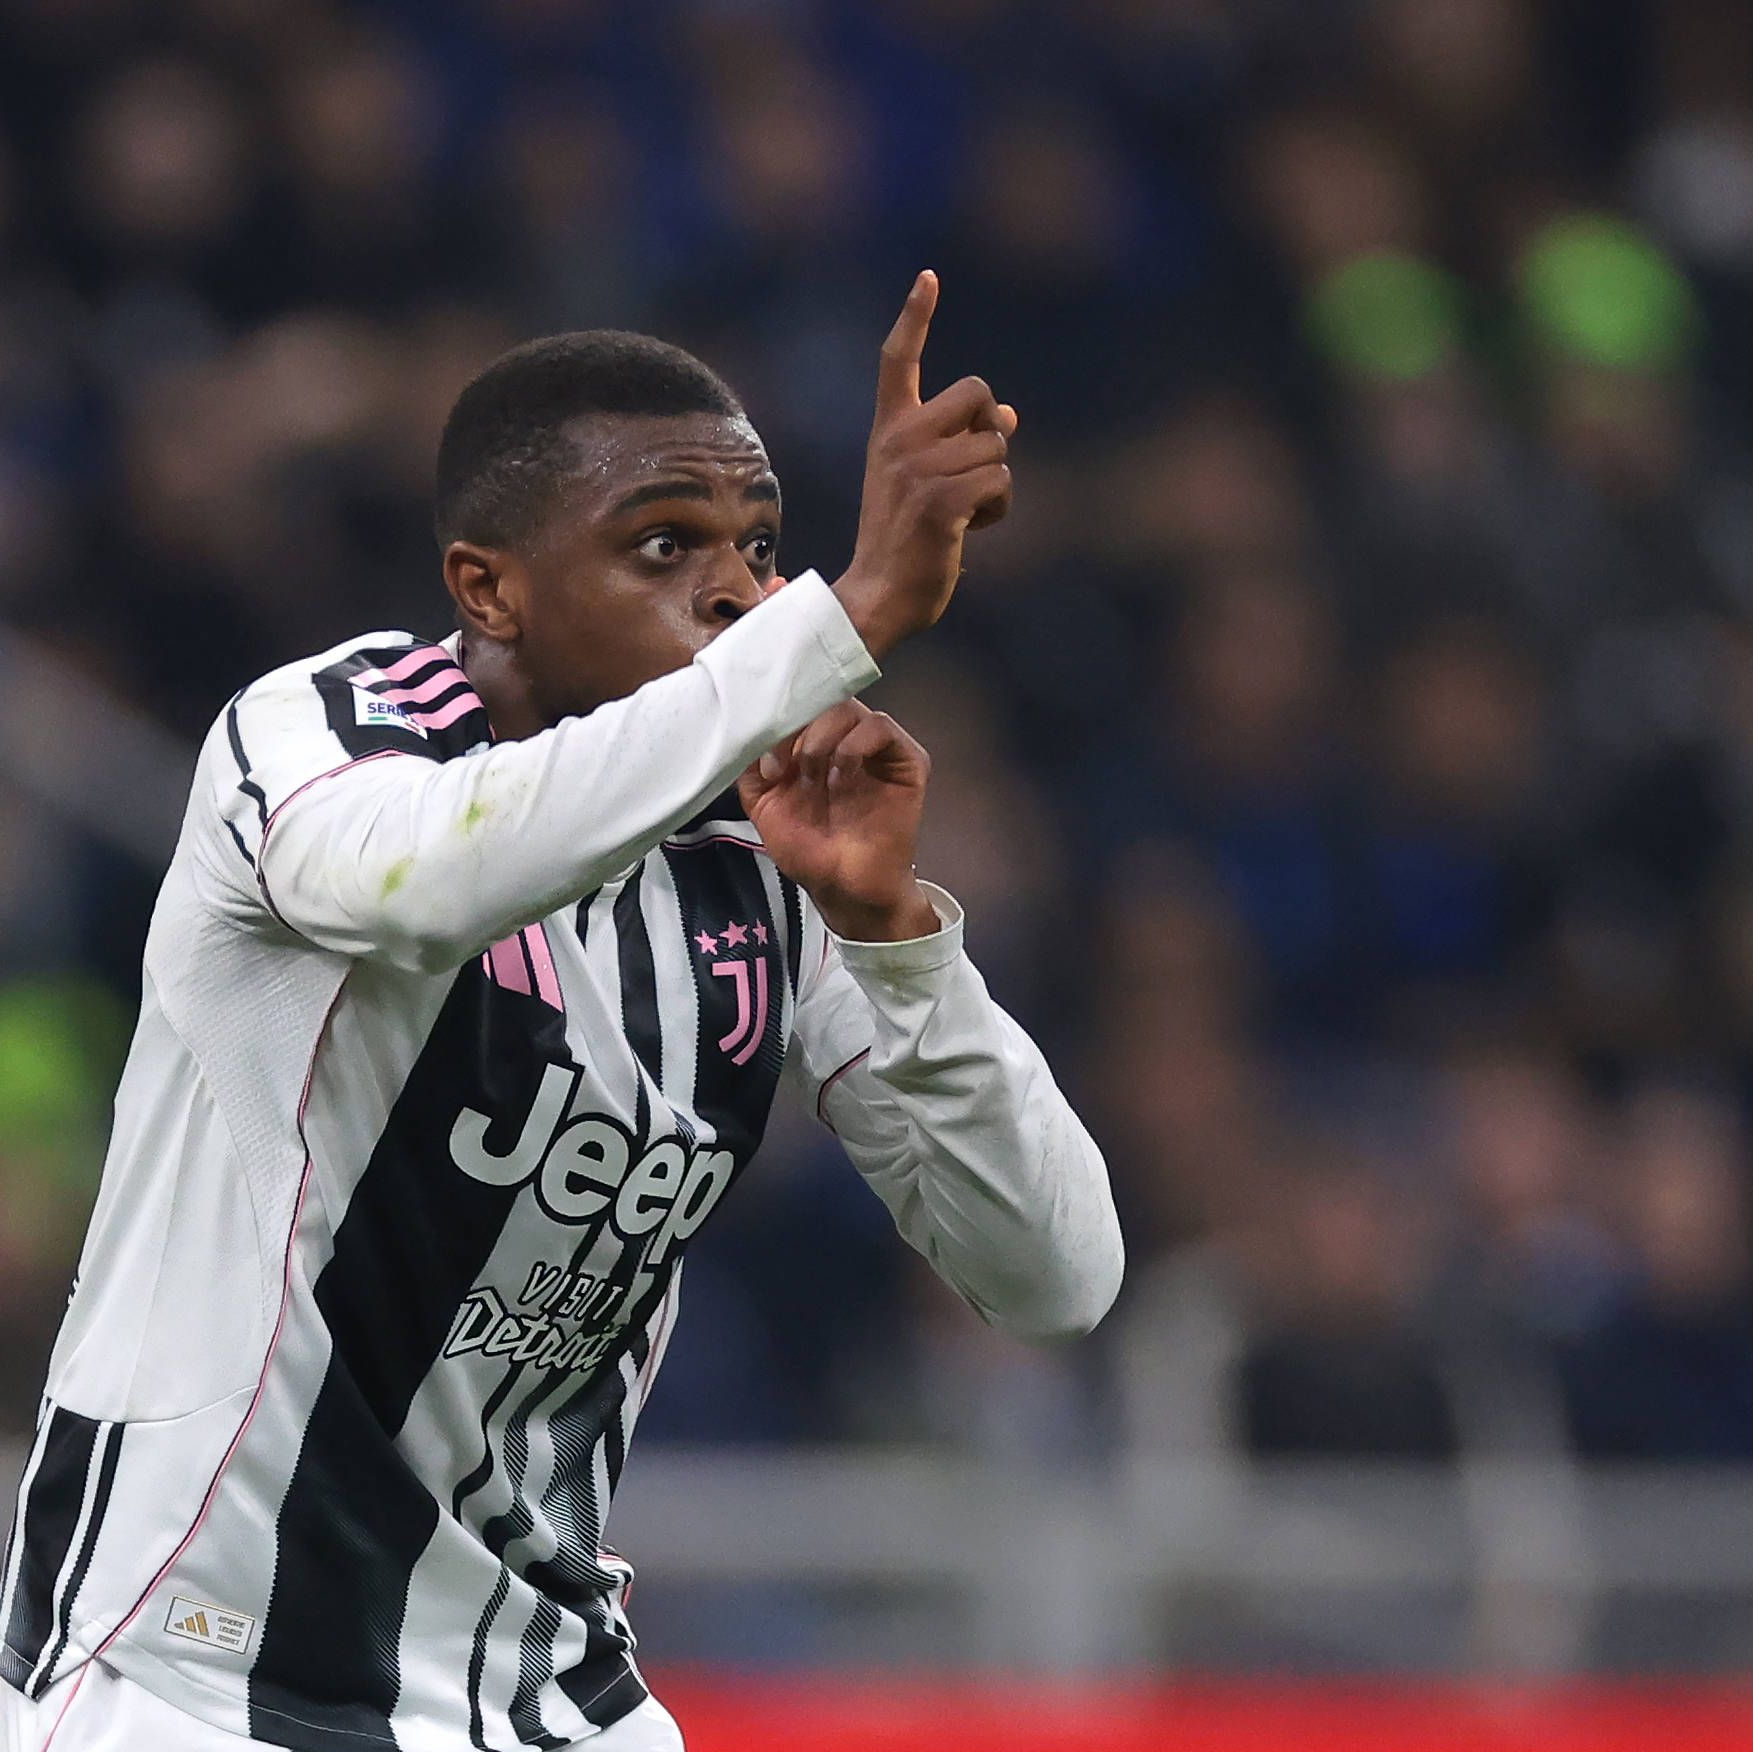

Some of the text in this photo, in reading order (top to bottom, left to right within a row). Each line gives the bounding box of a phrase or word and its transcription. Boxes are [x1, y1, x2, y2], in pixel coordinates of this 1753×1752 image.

[449, 1062, 734, 1264] Jeep
[446, 1289, 622, 1370] Detroit
[521, 1265, 624, 1321] VISIT
